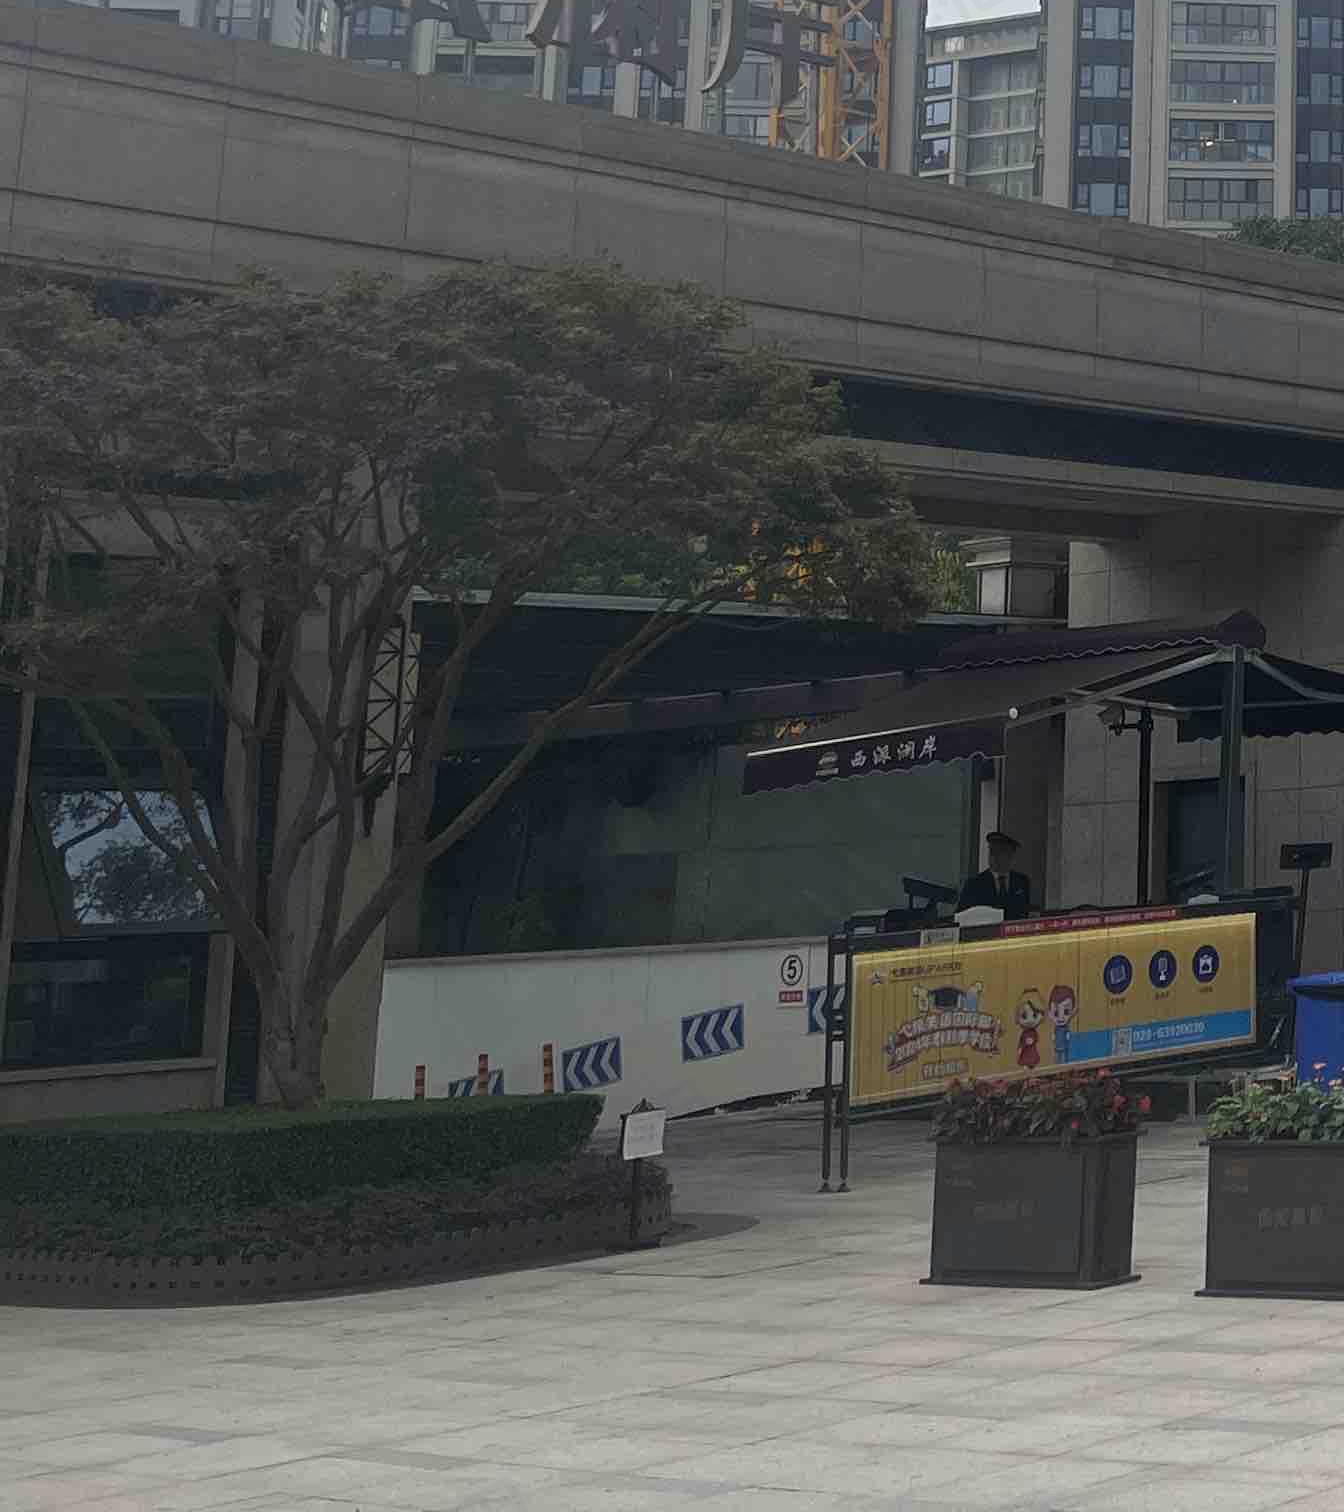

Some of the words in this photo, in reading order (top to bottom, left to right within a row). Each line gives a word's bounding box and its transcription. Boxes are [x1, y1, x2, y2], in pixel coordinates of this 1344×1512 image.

[850, 735, 937, 768] 西派澜岸
[787, 960, 798, 980] 5
